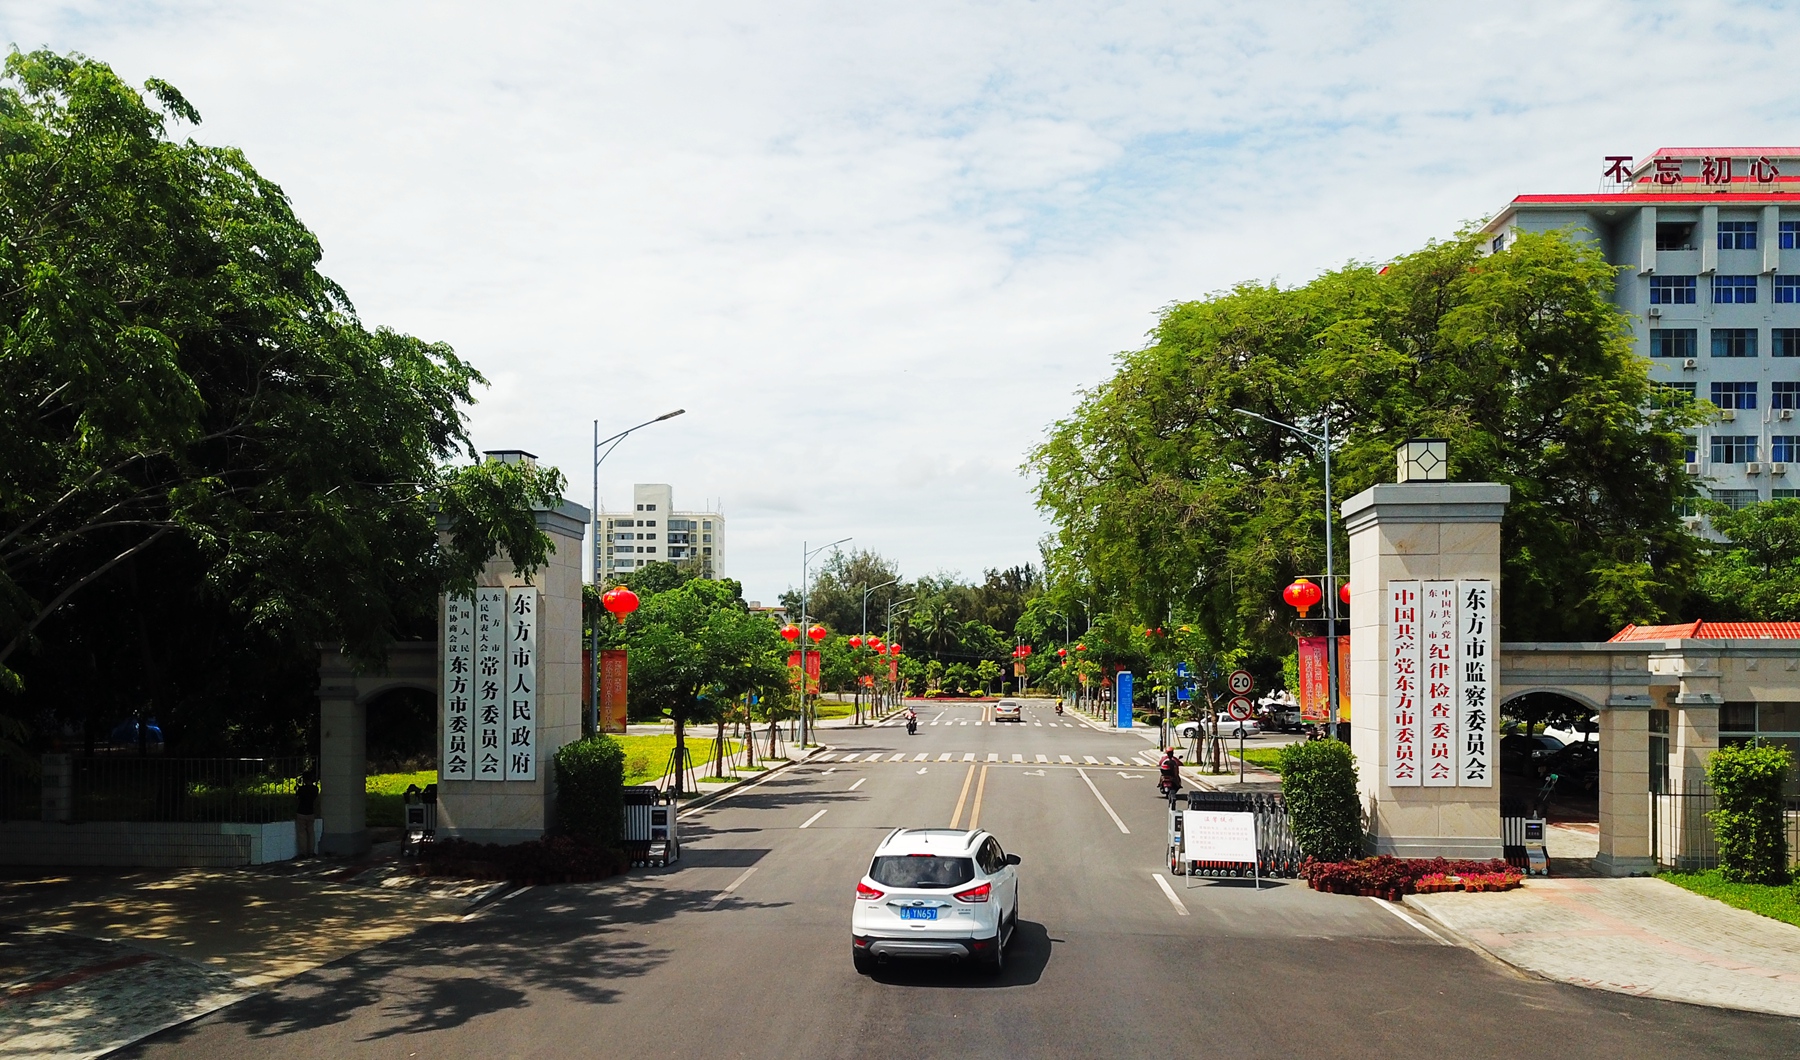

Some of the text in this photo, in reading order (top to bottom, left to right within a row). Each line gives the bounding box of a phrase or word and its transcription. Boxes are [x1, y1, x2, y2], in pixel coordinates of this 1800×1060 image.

[1604, 156, 1780, 185] 不忘初心
[480, 593, 489, 652] 人民代表大会
[492, 593, 501, 652] 东方市
[1428, 589, 1438, 639] 东方市
[1441, 589, 1451, 639] 中国共产党
[448, 656, 468, 773] 东方市委员会
[480, 656, 499, 773] 常务委员会
[511, 594, 531, 774] 东方市人民政府
[1233, 677, 1249, 688] 20
[1394, 589, 1415, 779] 中国共产党东方市委员会
[1429, 643, 1451, 779] 纪律检查委员会
[1465, 588, 1486, 780] 东方市监察委员会
